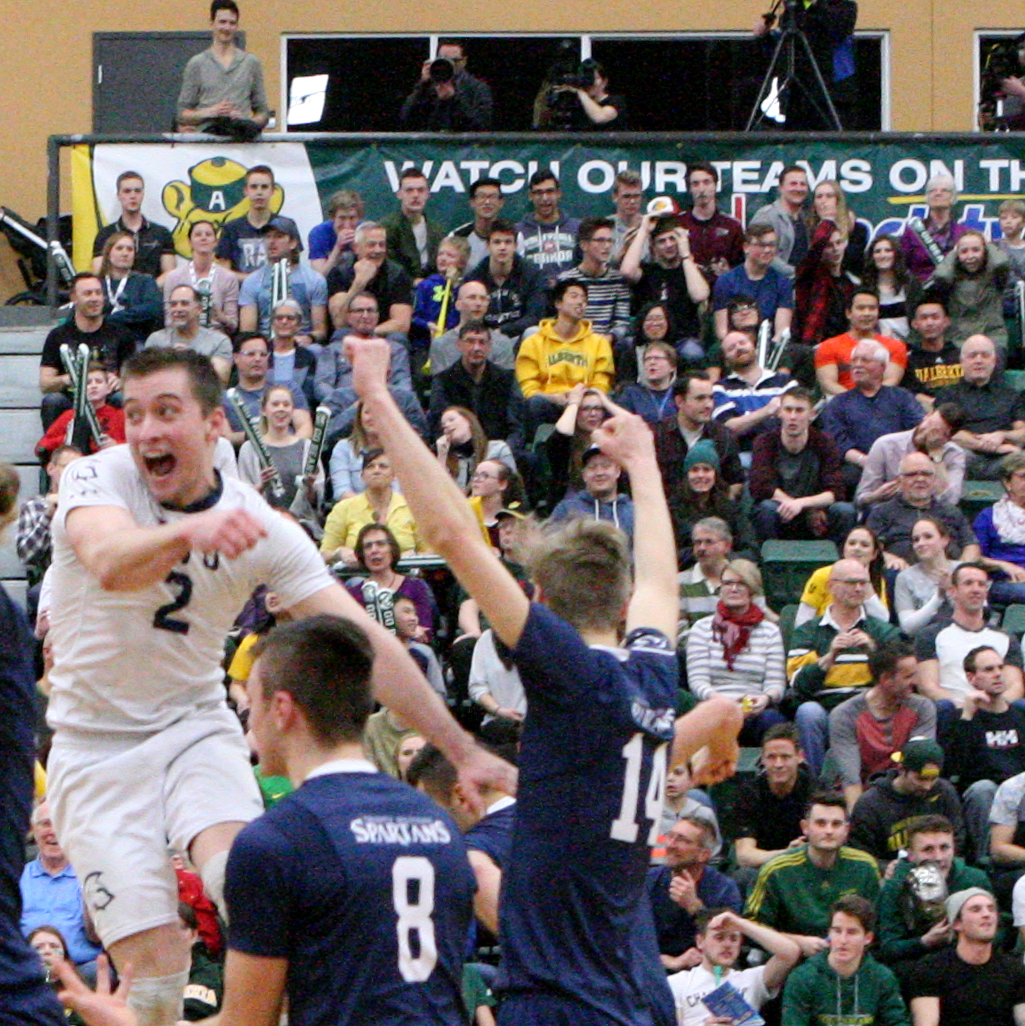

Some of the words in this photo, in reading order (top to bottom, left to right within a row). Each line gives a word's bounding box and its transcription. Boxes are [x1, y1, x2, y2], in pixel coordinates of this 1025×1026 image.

[209, 191, 226, 211] A
[889, 159, 964, 193] ON
[152, 571, 193, 635] 2
[609, 733, 669, 847] 14
[392, 857, 438, 983] 8
